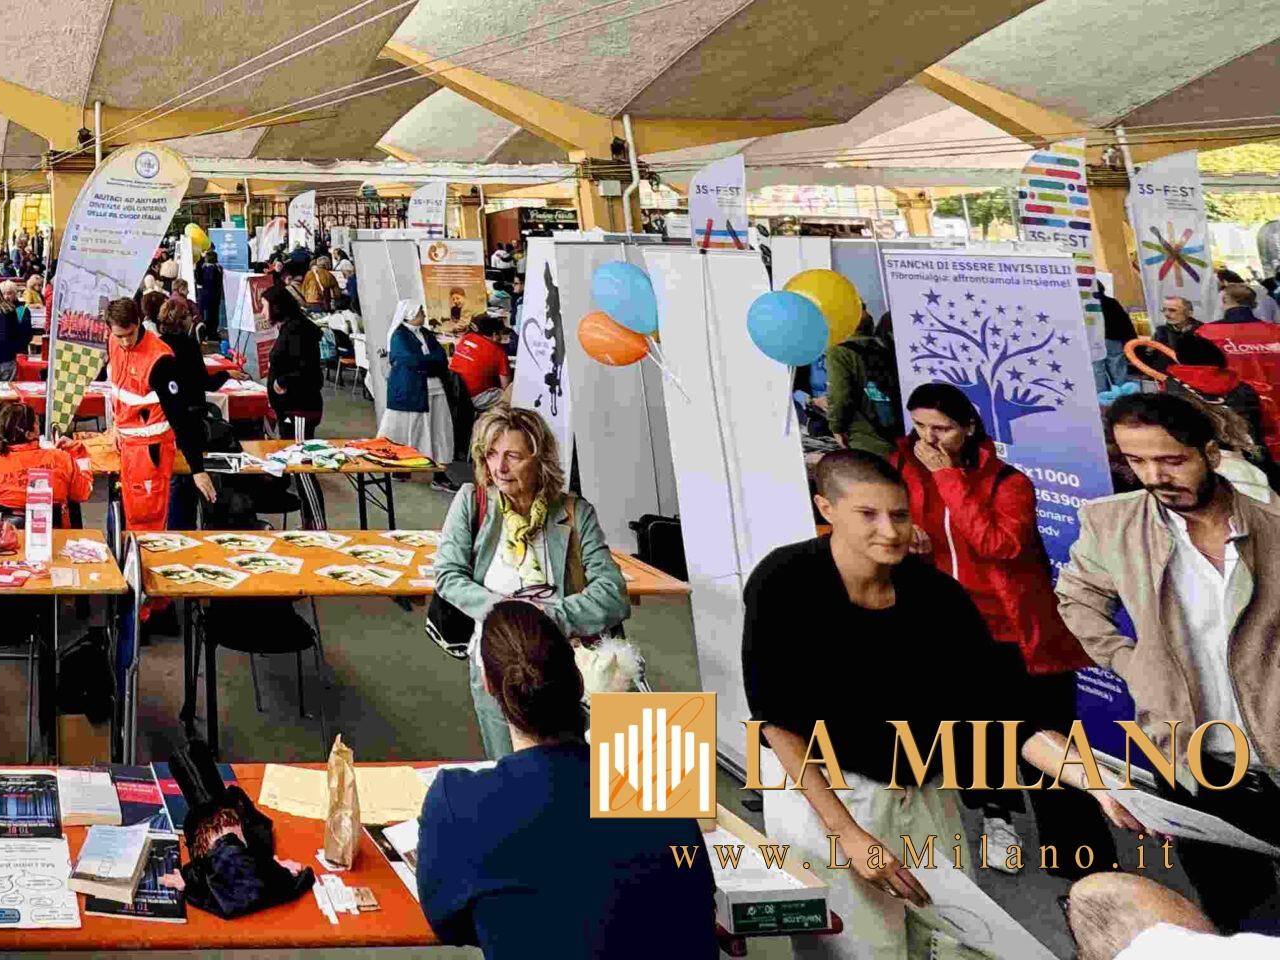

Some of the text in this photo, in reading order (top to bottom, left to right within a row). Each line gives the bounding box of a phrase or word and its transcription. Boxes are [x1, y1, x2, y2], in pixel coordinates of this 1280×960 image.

[887, 260, 934, 270] STANCHI
[936, 261, 949, 270] DI
[952, 261, 994, 272] ESSERE
